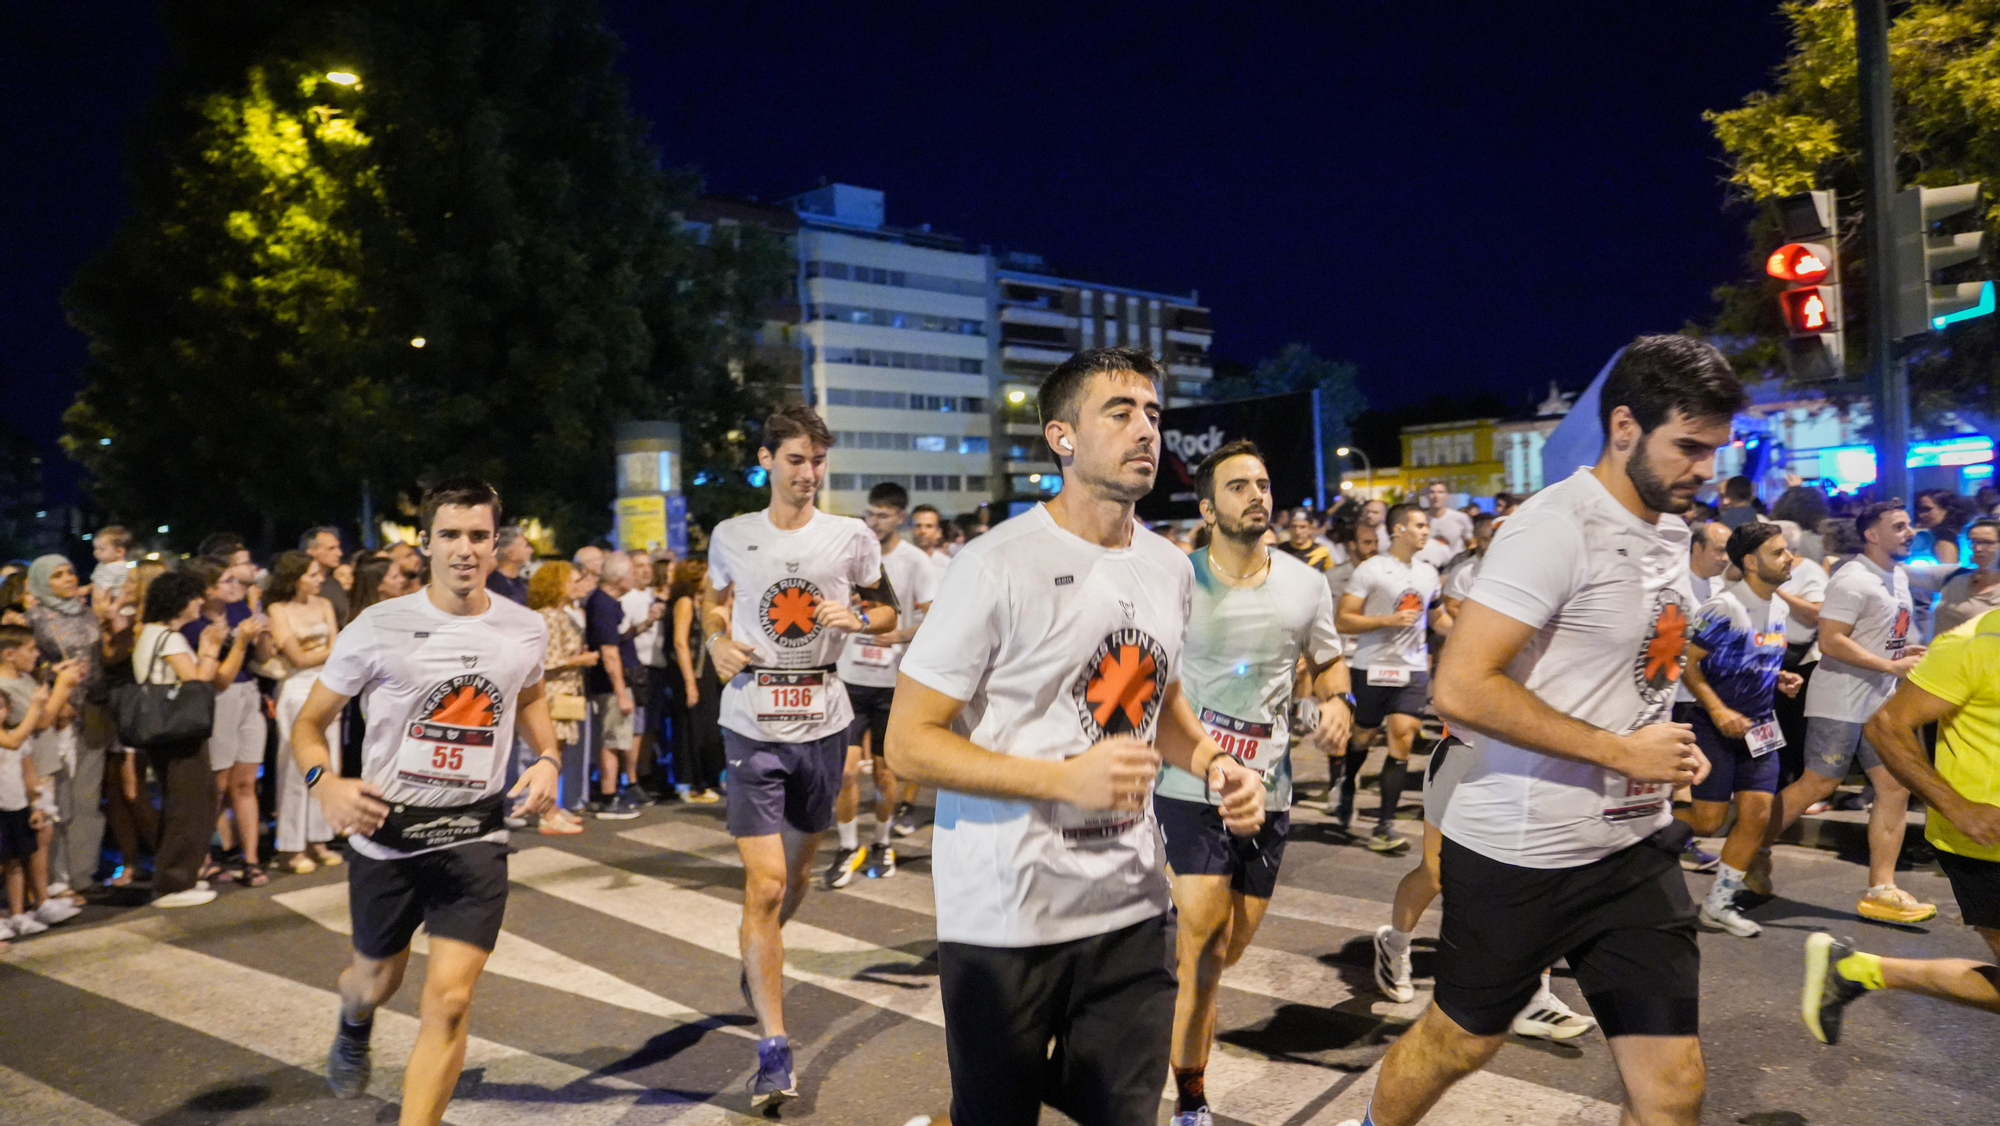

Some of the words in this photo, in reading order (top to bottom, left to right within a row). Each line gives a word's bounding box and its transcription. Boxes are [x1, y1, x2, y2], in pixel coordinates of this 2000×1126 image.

[1162, 425, 1225, 462] Rock
[779, 579, 807, 590] RUN
[760, 586, 780, 641] RUNNERS
[779, 622, 823, 647] UNNING
[1112, 628, 1149, 649] RUN
[453, 675, 485, 688] RUN
[772, 688, 812, 707] 1136
[432, 746, 464, 770] 55
